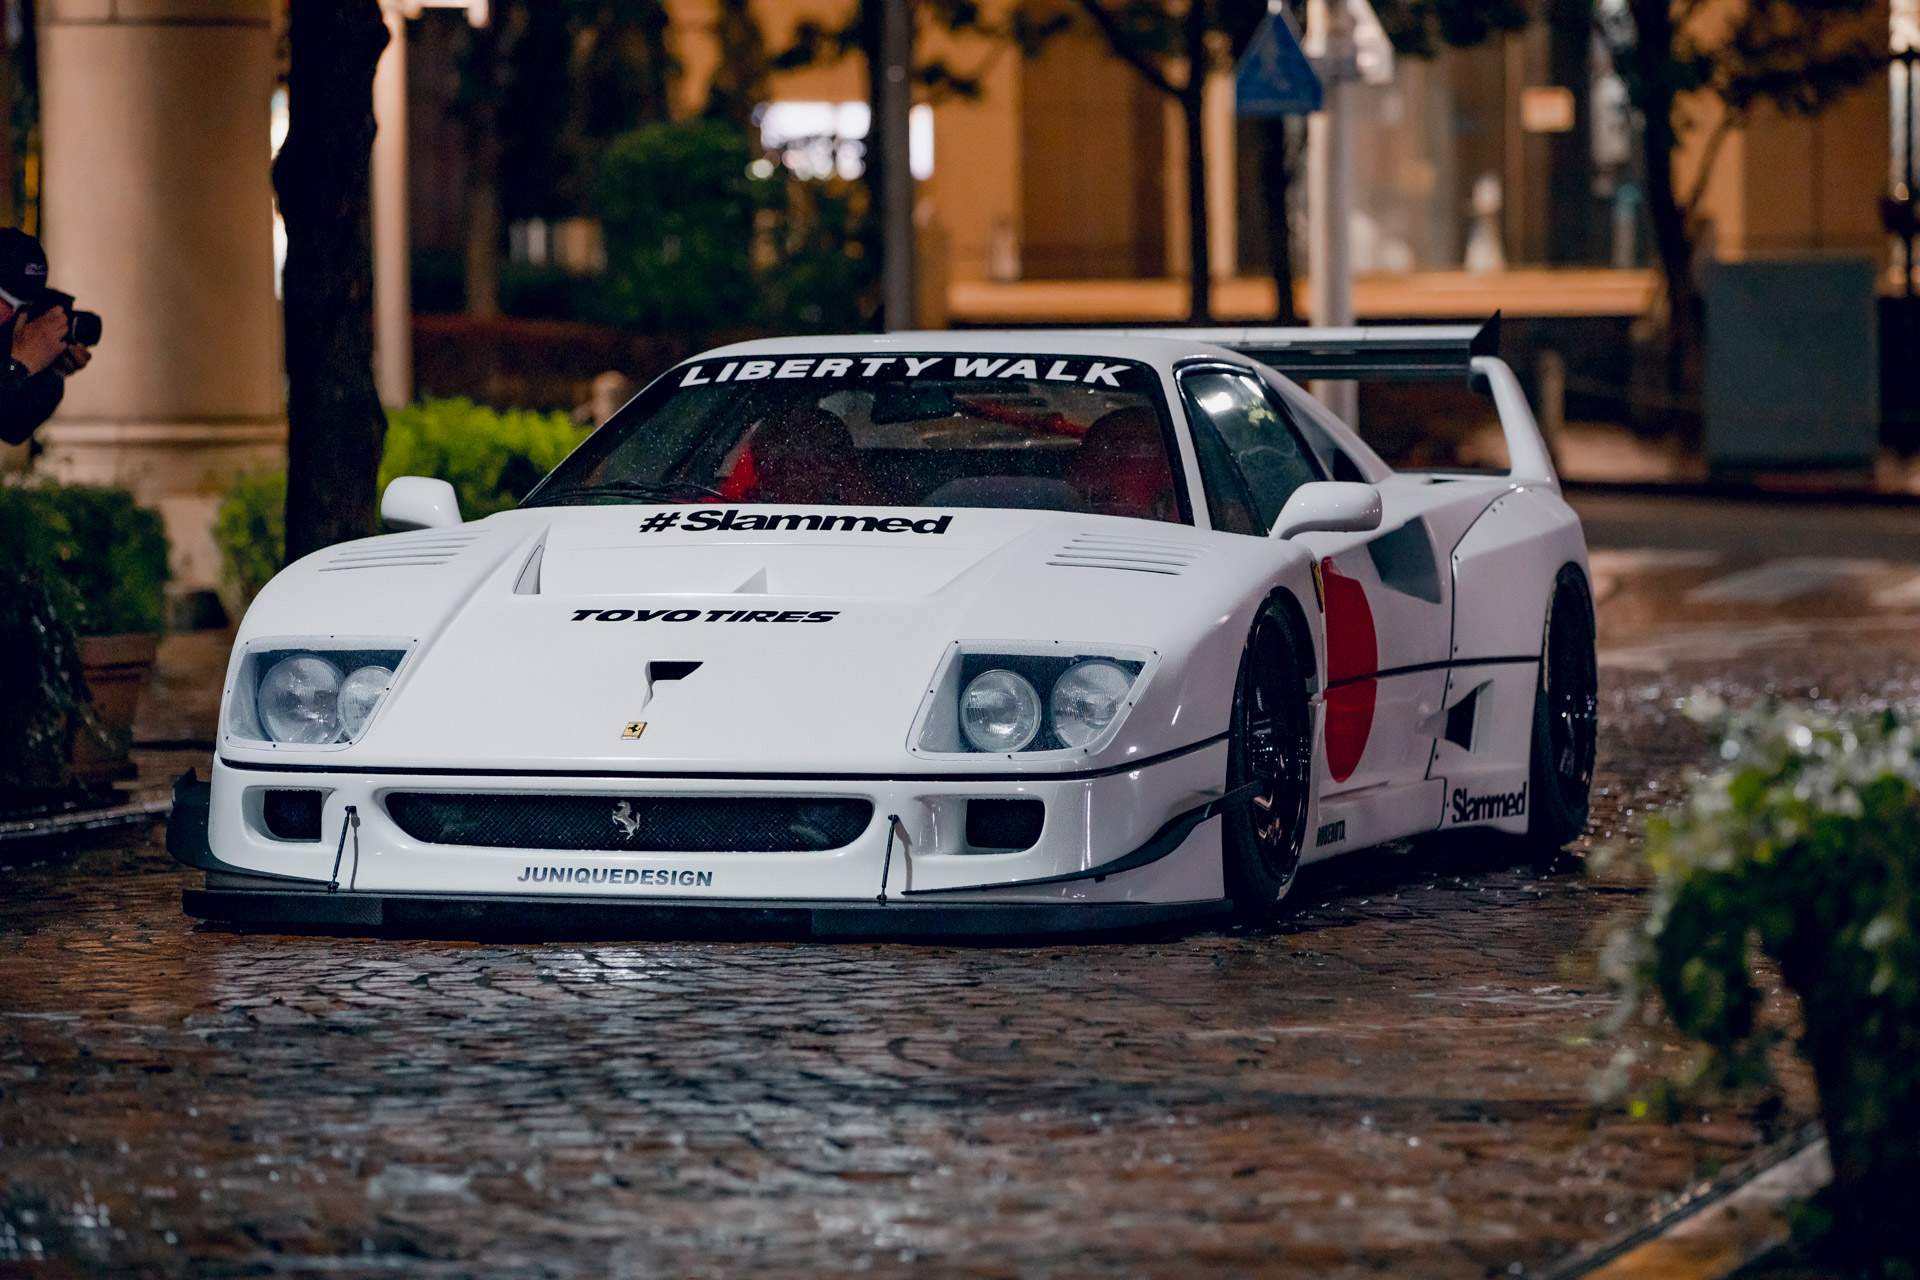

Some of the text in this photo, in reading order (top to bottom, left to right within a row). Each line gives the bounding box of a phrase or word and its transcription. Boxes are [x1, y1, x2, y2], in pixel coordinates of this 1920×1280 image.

[679, 357, 1132, 388] LIBERTY WALK
[639, 509, 953, 535] #Slammed
[571, 609, 841, 623] TOYO TIRES
[1452, 781, 1527, 824] Slammed
[517, 866, 713, 887] JUNIQUEDESIGN
